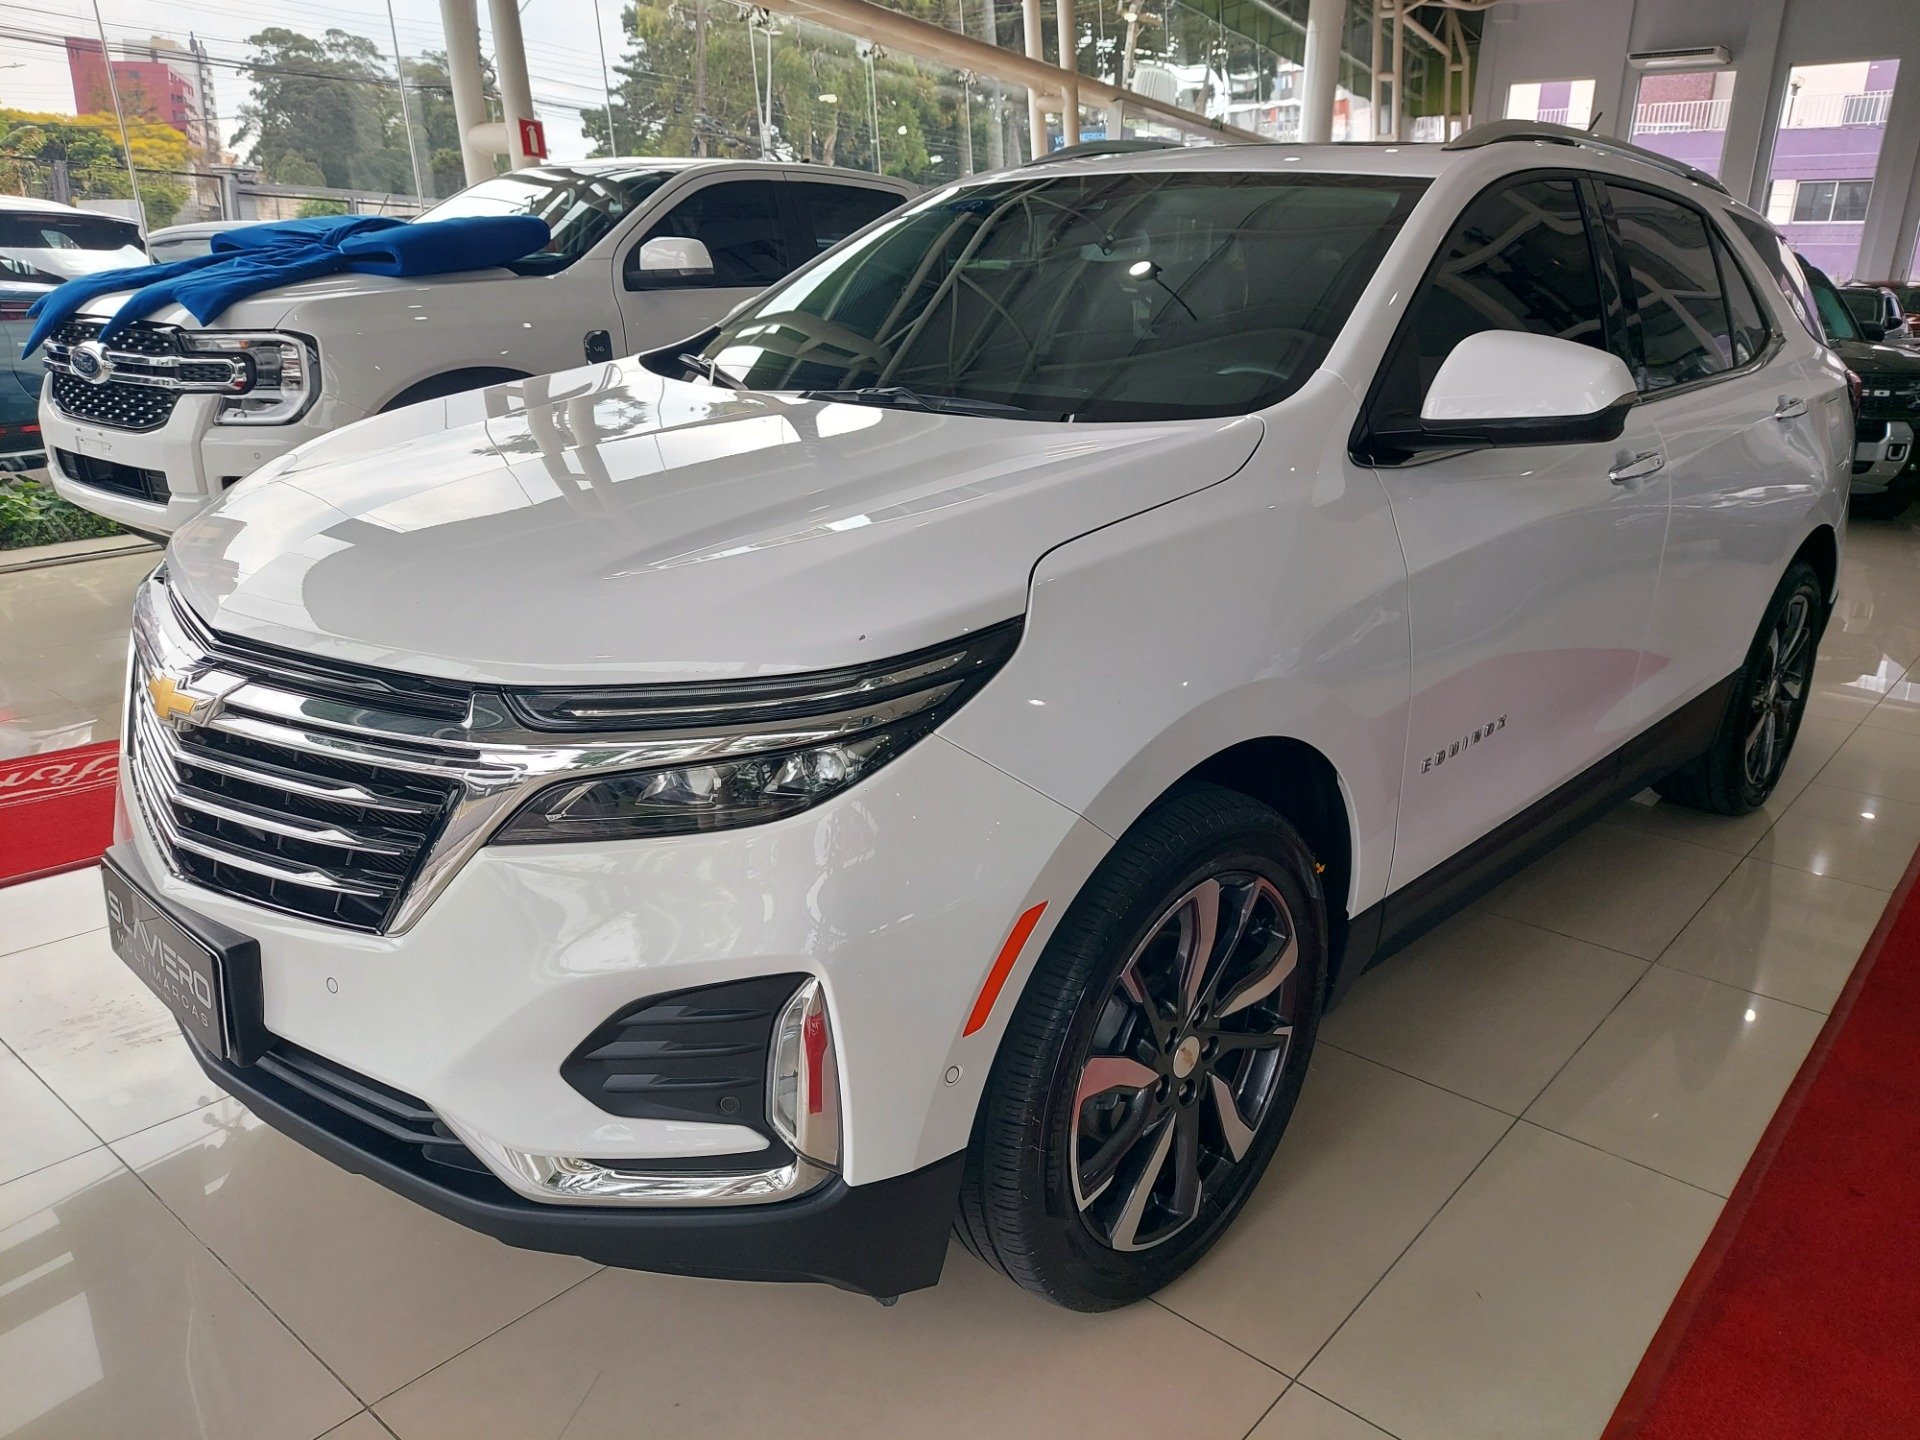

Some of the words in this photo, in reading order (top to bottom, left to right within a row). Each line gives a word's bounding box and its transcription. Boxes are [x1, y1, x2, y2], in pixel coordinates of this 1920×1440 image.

[1421, 714, 1507, 774] EQUINOX
[107, 890, 211, 1009] SLAVIERO
[116, 933, 208, 1027] MULTIMARCAS
